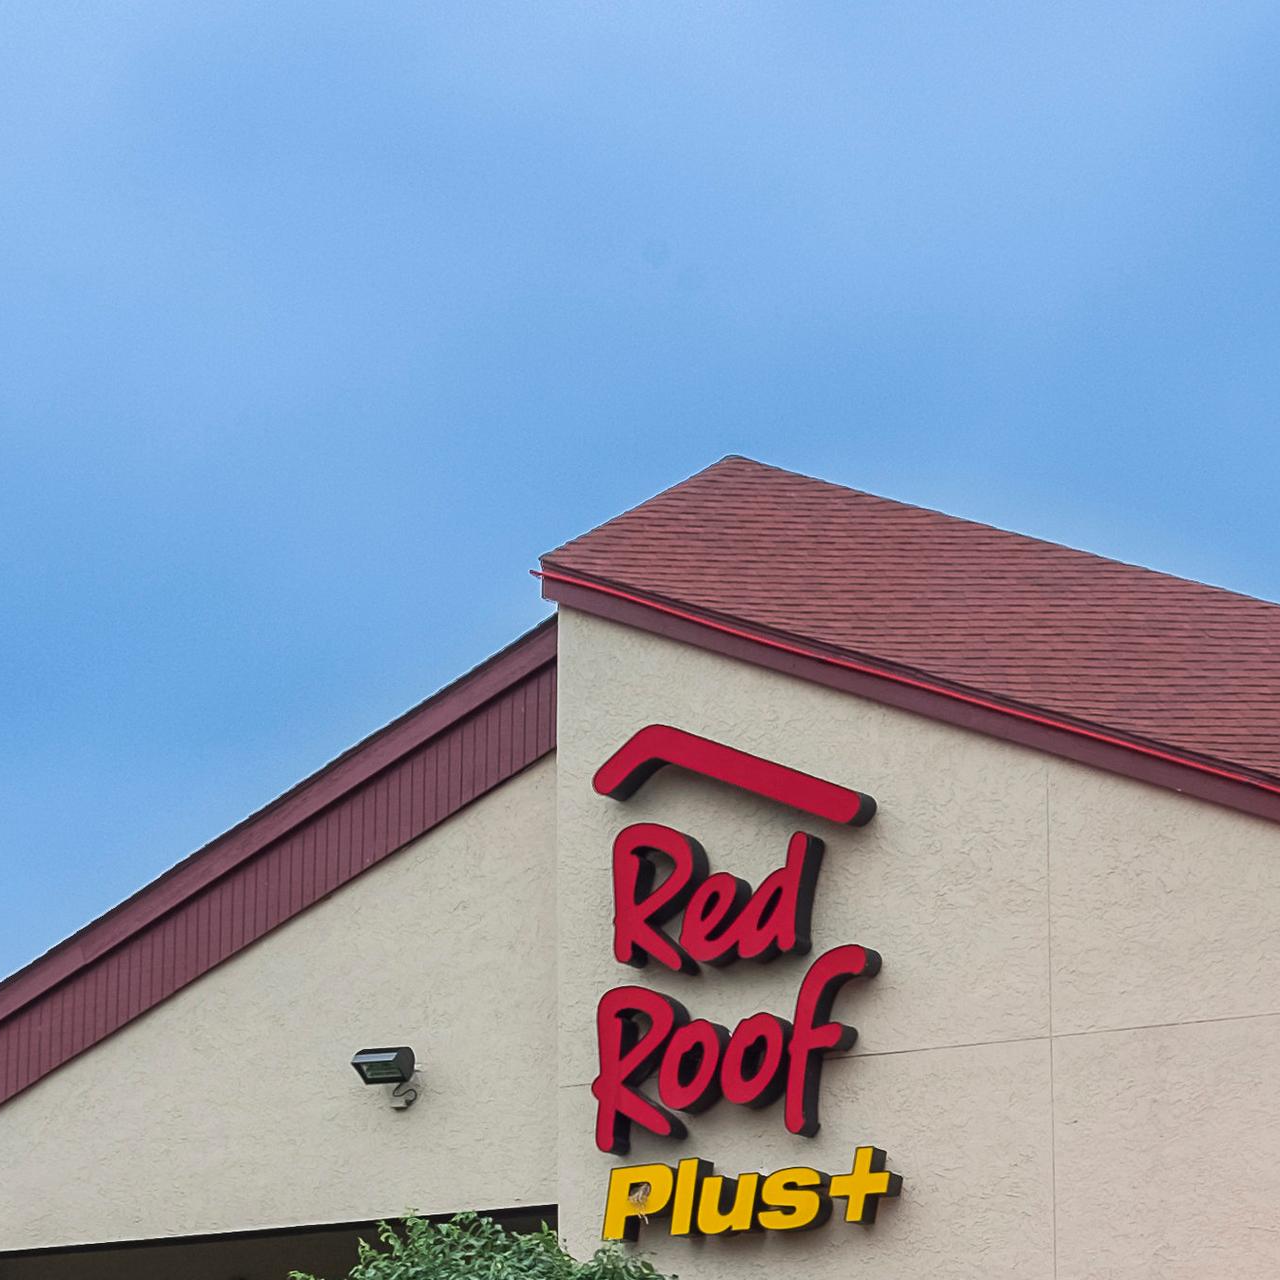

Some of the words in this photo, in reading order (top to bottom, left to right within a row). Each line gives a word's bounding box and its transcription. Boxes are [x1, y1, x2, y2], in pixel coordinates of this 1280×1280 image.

[613, 822, 824, 975] Red
[592, 943, 881, 1154] Roof
[602, 1146, 902, 1242] Plus+
